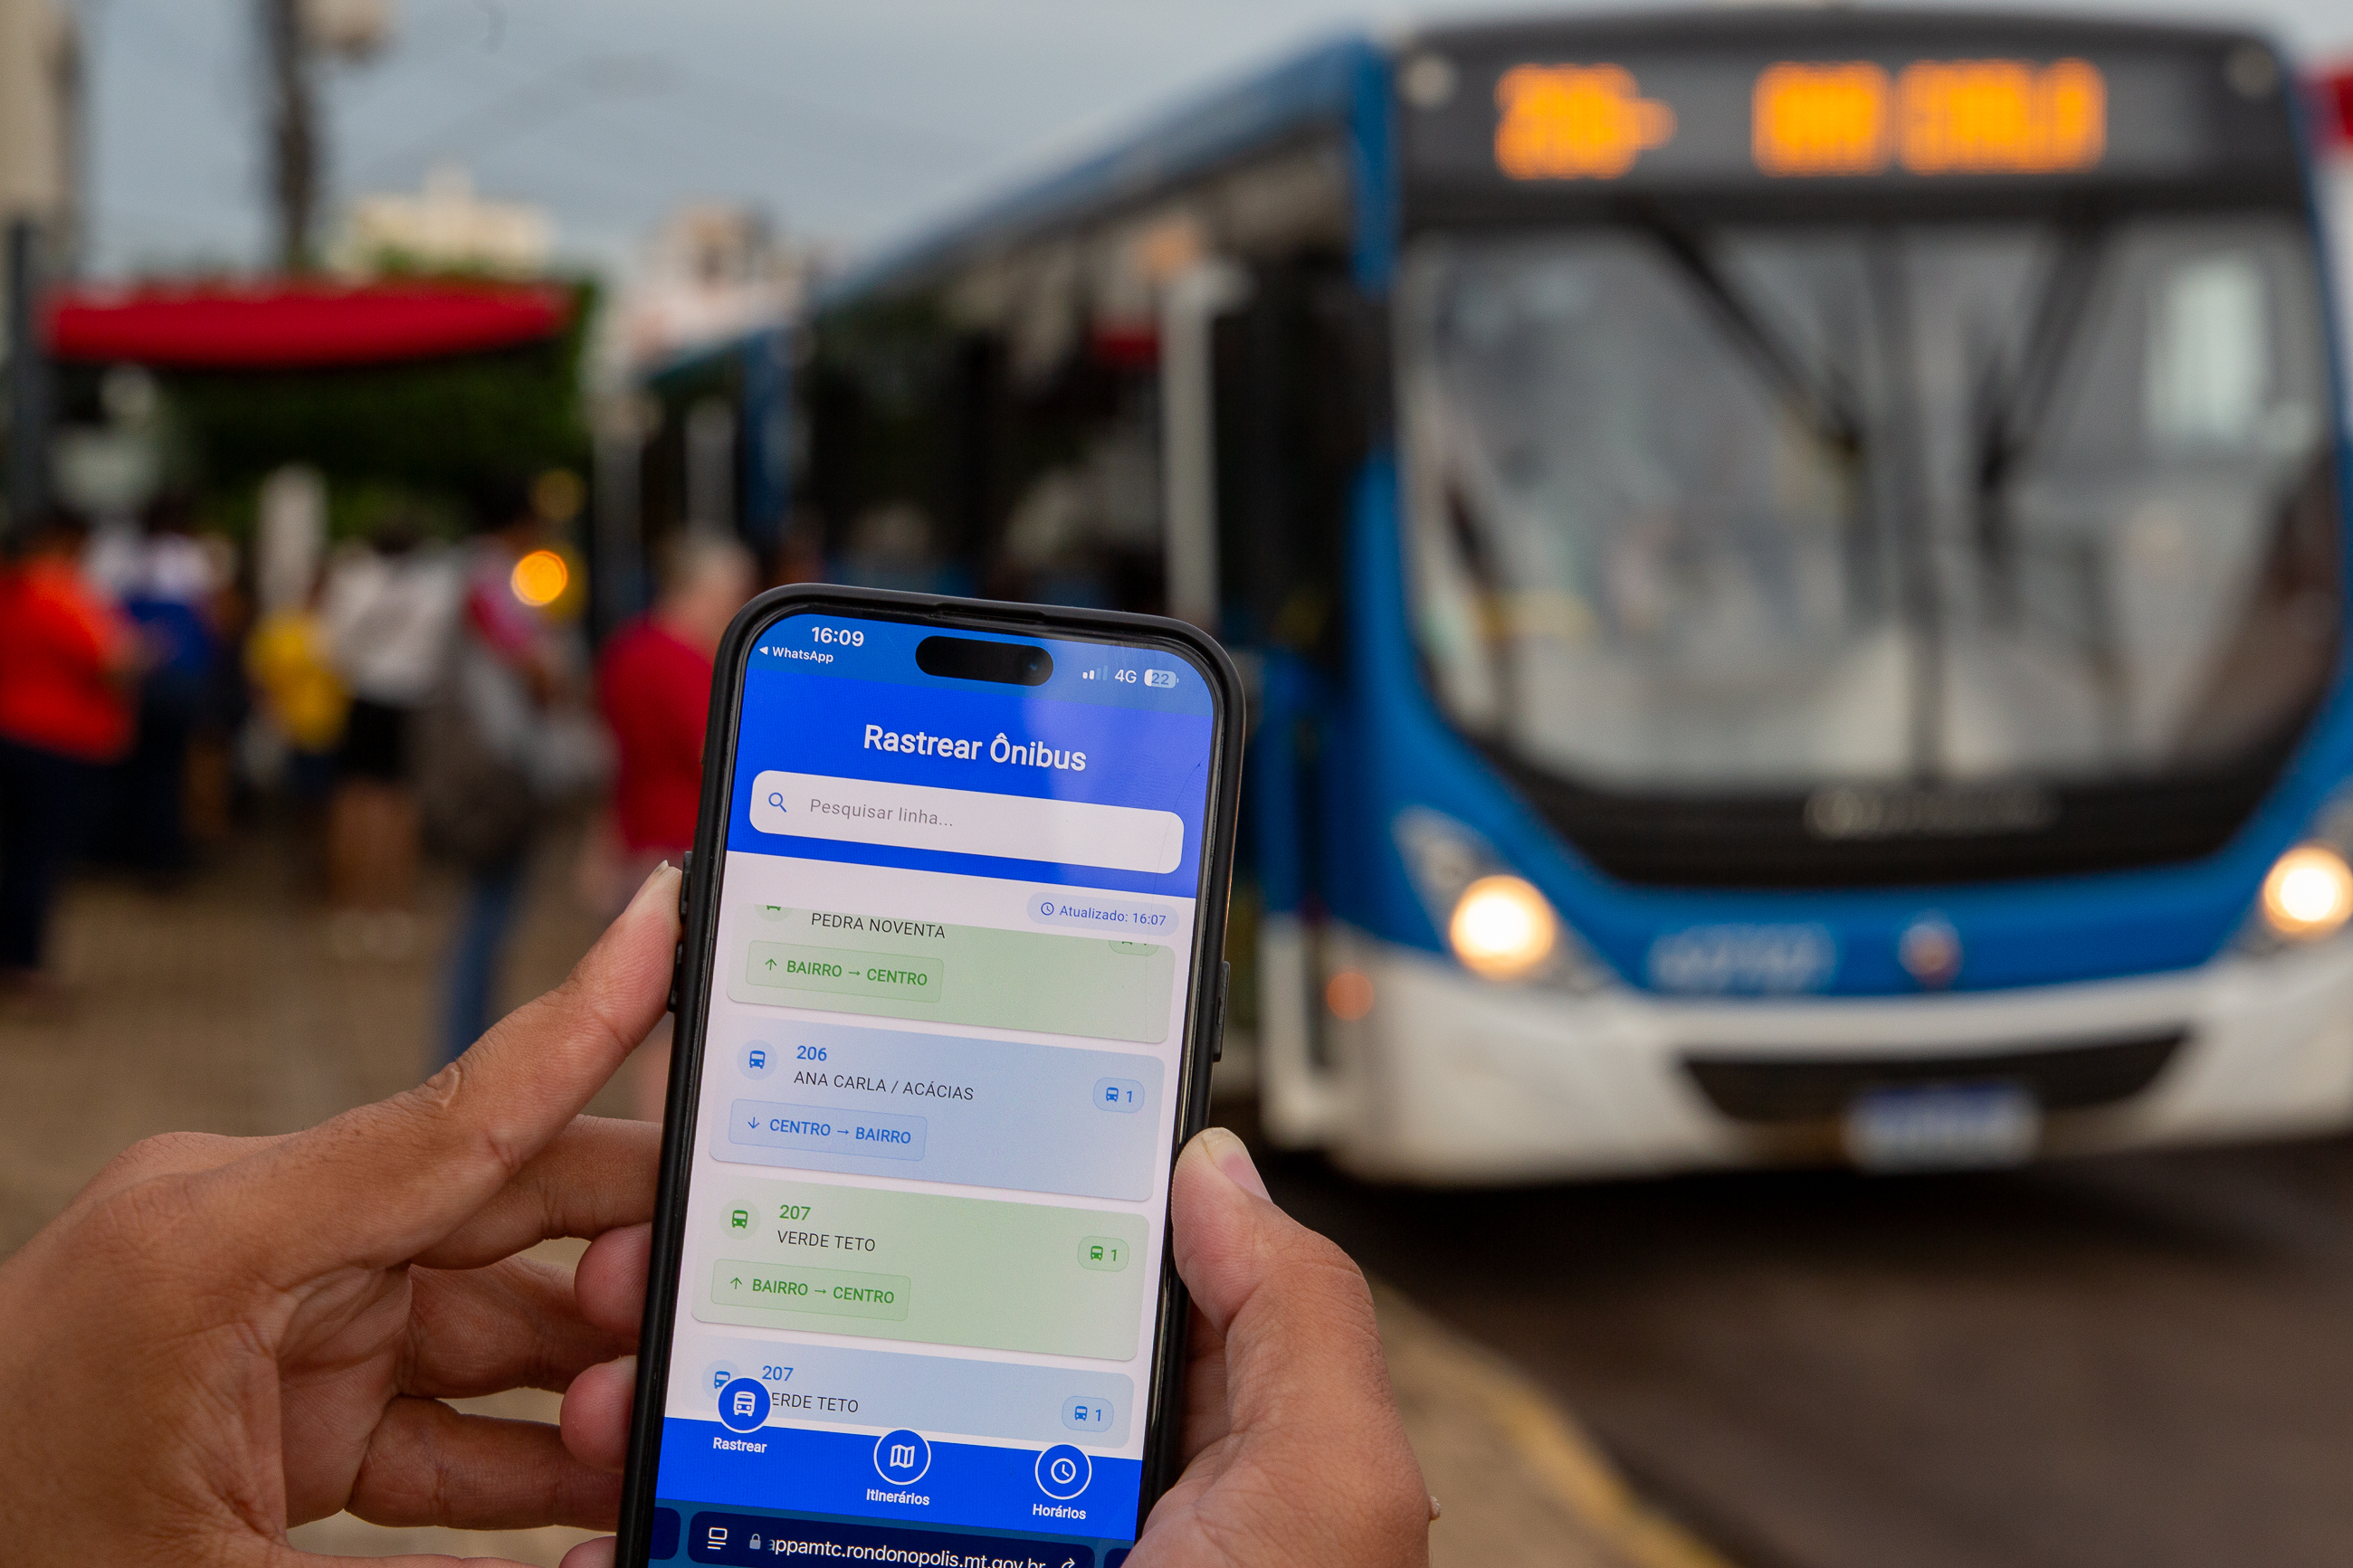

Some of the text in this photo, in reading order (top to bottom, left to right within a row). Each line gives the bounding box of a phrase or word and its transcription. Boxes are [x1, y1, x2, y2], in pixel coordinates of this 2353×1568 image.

[811, 626, 864, 647] 16:09
[772, 646, 834, 664] WhatsApp
[1114, 669, 1138, 685] 4G
[1150, 671, 1169, 686] 22
[862, 725, 1087, 772] Rastrear Ônibus
[809, 797, 954, 827] Pesquisar linha...
[1059, 905, 1167, 926] Atualizado: 16:07
[811, 912, 946, 939] PEDRA NOVENTA
[786, 960, 928, 986] BAIRRO CENTRO
[796, 1045, 827, 1062] 206
[794, 1070, 975, 1101] ANA CARLA / ACÁCIAS
[1127, 1090, 1134, 1104] 1
[769, 1118, 911, 1145] CENTRO BAIRRO
[778, 1204, 811, 1221] 207
[777, 1231, 876, 1252] VERDE TETO
[1111, 1249, 1118, 1261] 1
[752, 1278, 895, 1305] BAIRRO CENTRO
[761, 1365, 794, 1382] 207
[769, 1392, 860, 1413] ERDE TETO
[1095, 1409, 1102, 1422] 1
[713, 1437, 767, 1454] Rastrear
[866, 1487, 930, 1506] Itinerários
[1032, 1503, 1087, 1521] Horários
